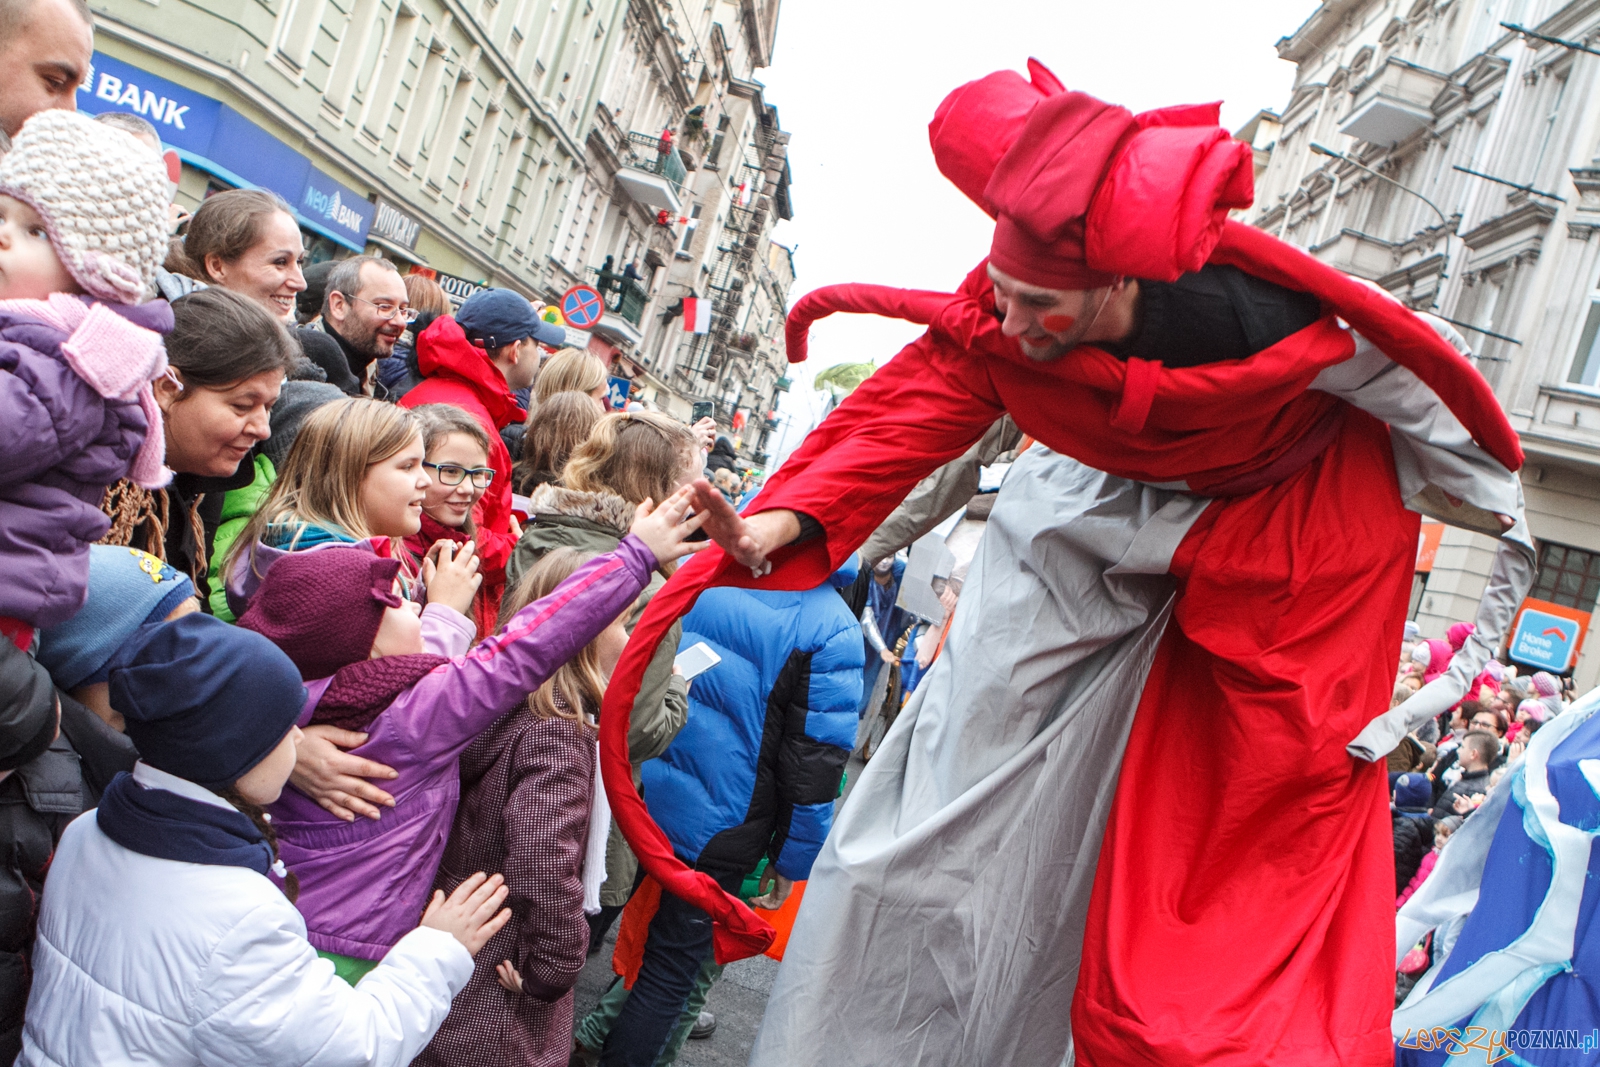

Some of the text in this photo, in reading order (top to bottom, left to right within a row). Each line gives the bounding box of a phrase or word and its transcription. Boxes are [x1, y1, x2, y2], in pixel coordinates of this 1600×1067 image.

[95, 72, 190, 130] BANK
[338, 204, 363, 233] BANK
[374, 202, 419, 247] FOTOGRAF
[1518, 641, 1553, 660] Broker
[1521, 631, 1552, 649] Home
